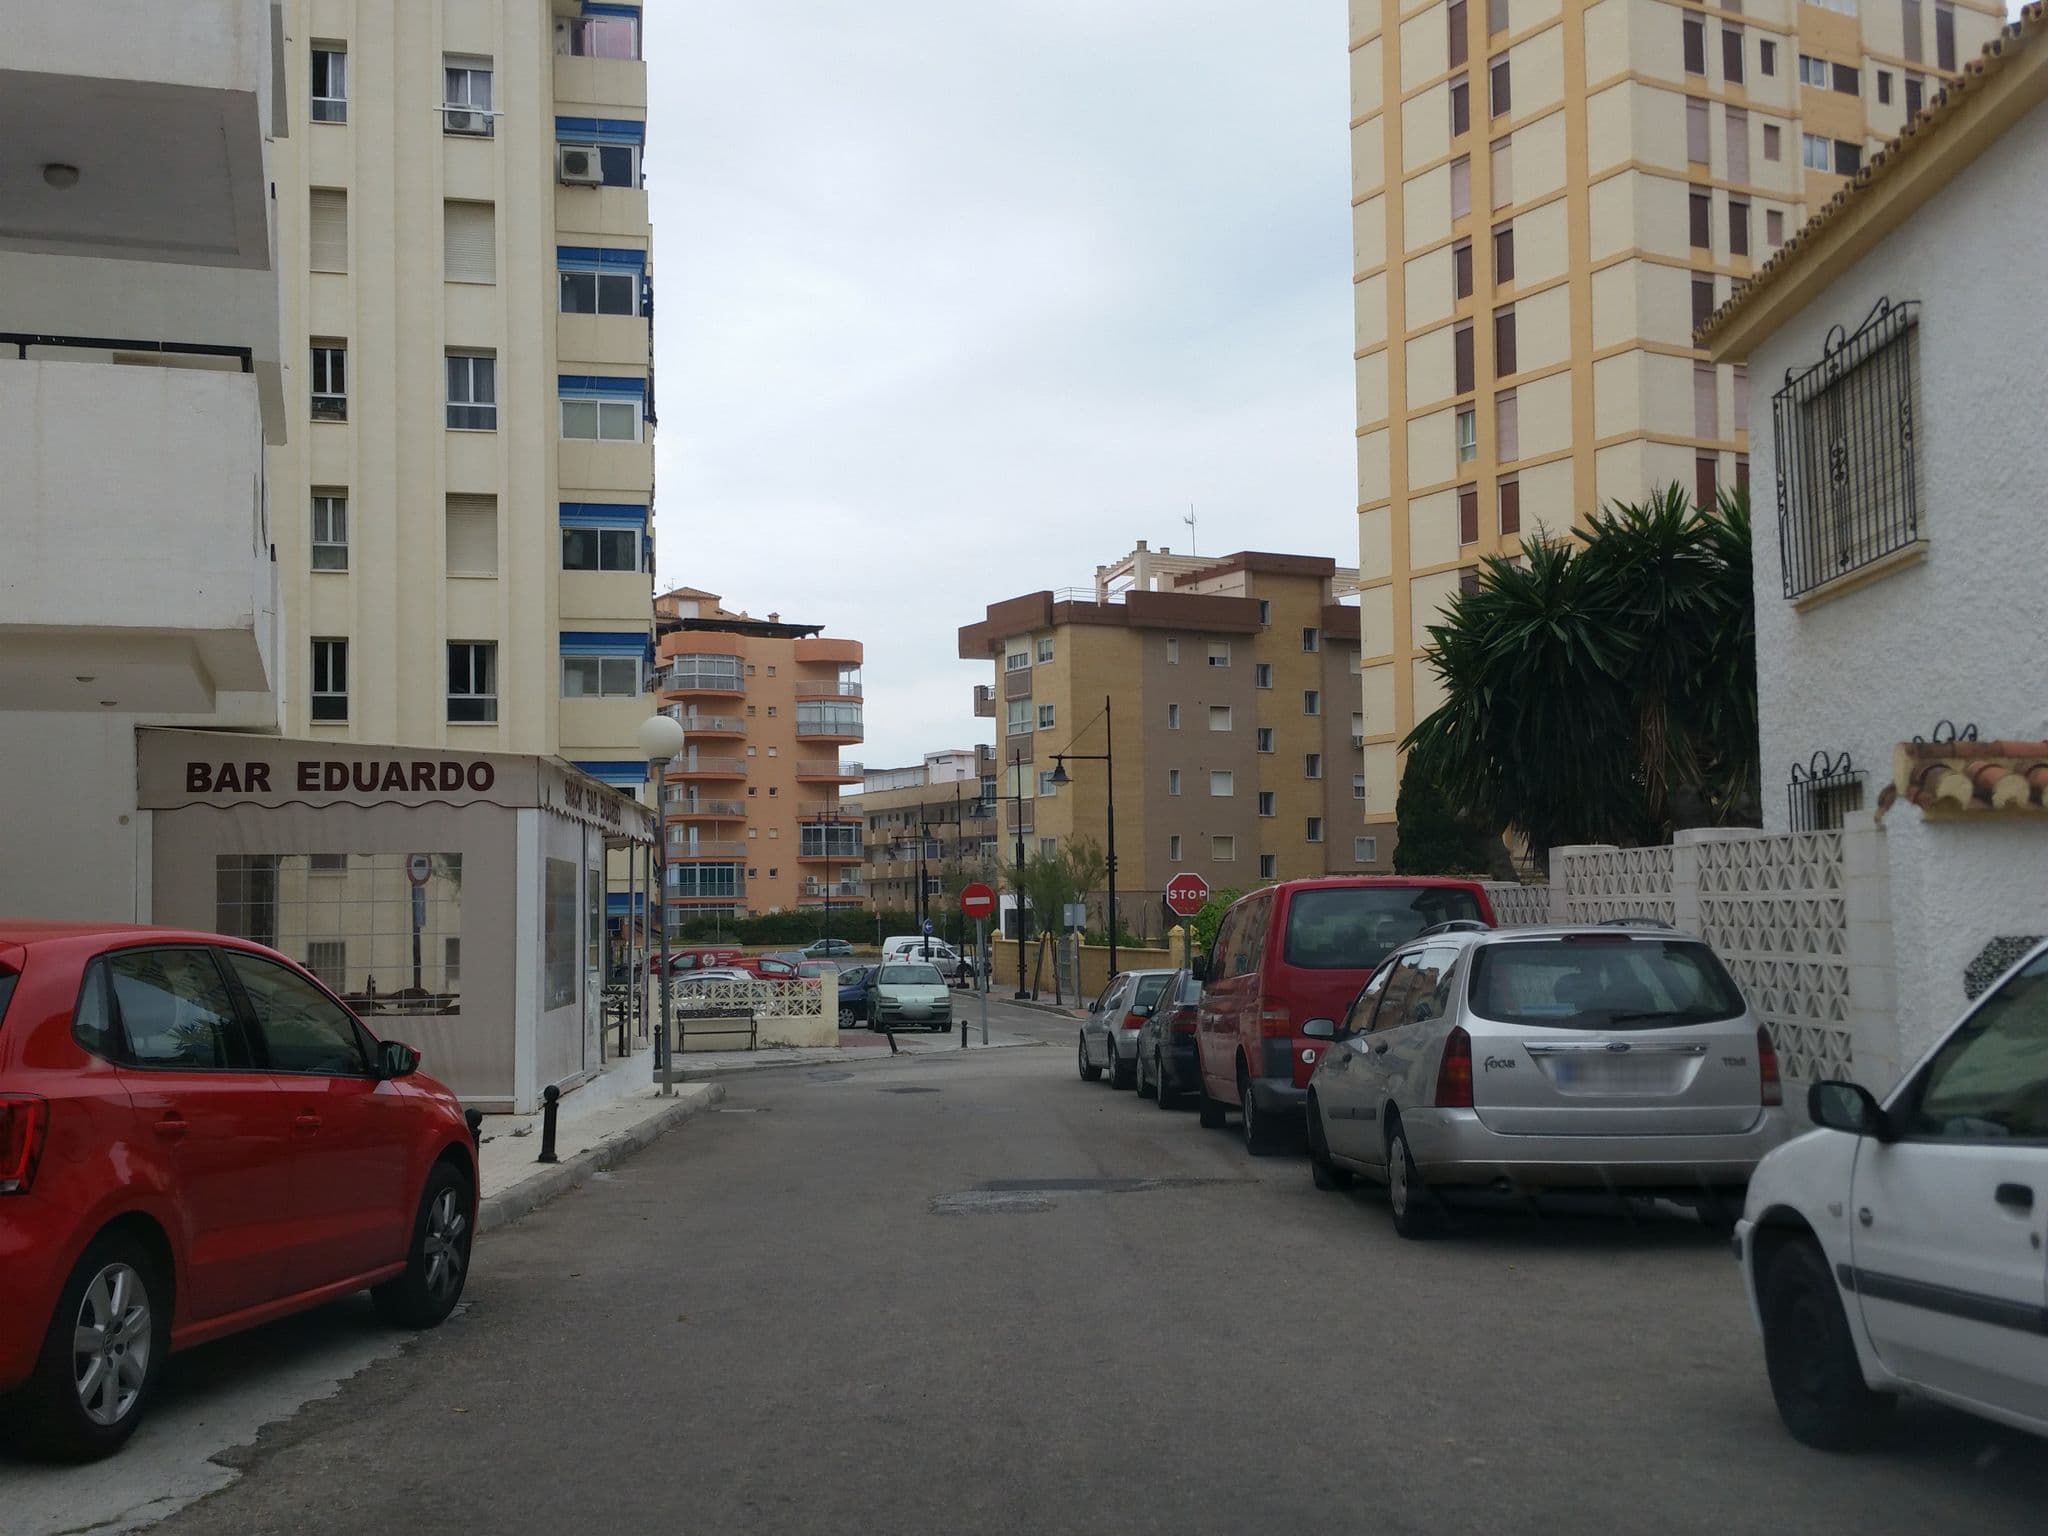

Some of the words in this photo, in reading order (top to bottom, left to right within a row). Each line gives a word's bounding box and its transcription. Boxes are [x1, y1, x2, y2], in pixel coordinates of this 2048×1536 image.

[186, 762, 272, 793] BAR
[297, 761, 495, 792] EDUARDO
[1170, 889, 1206, 900] STOP
